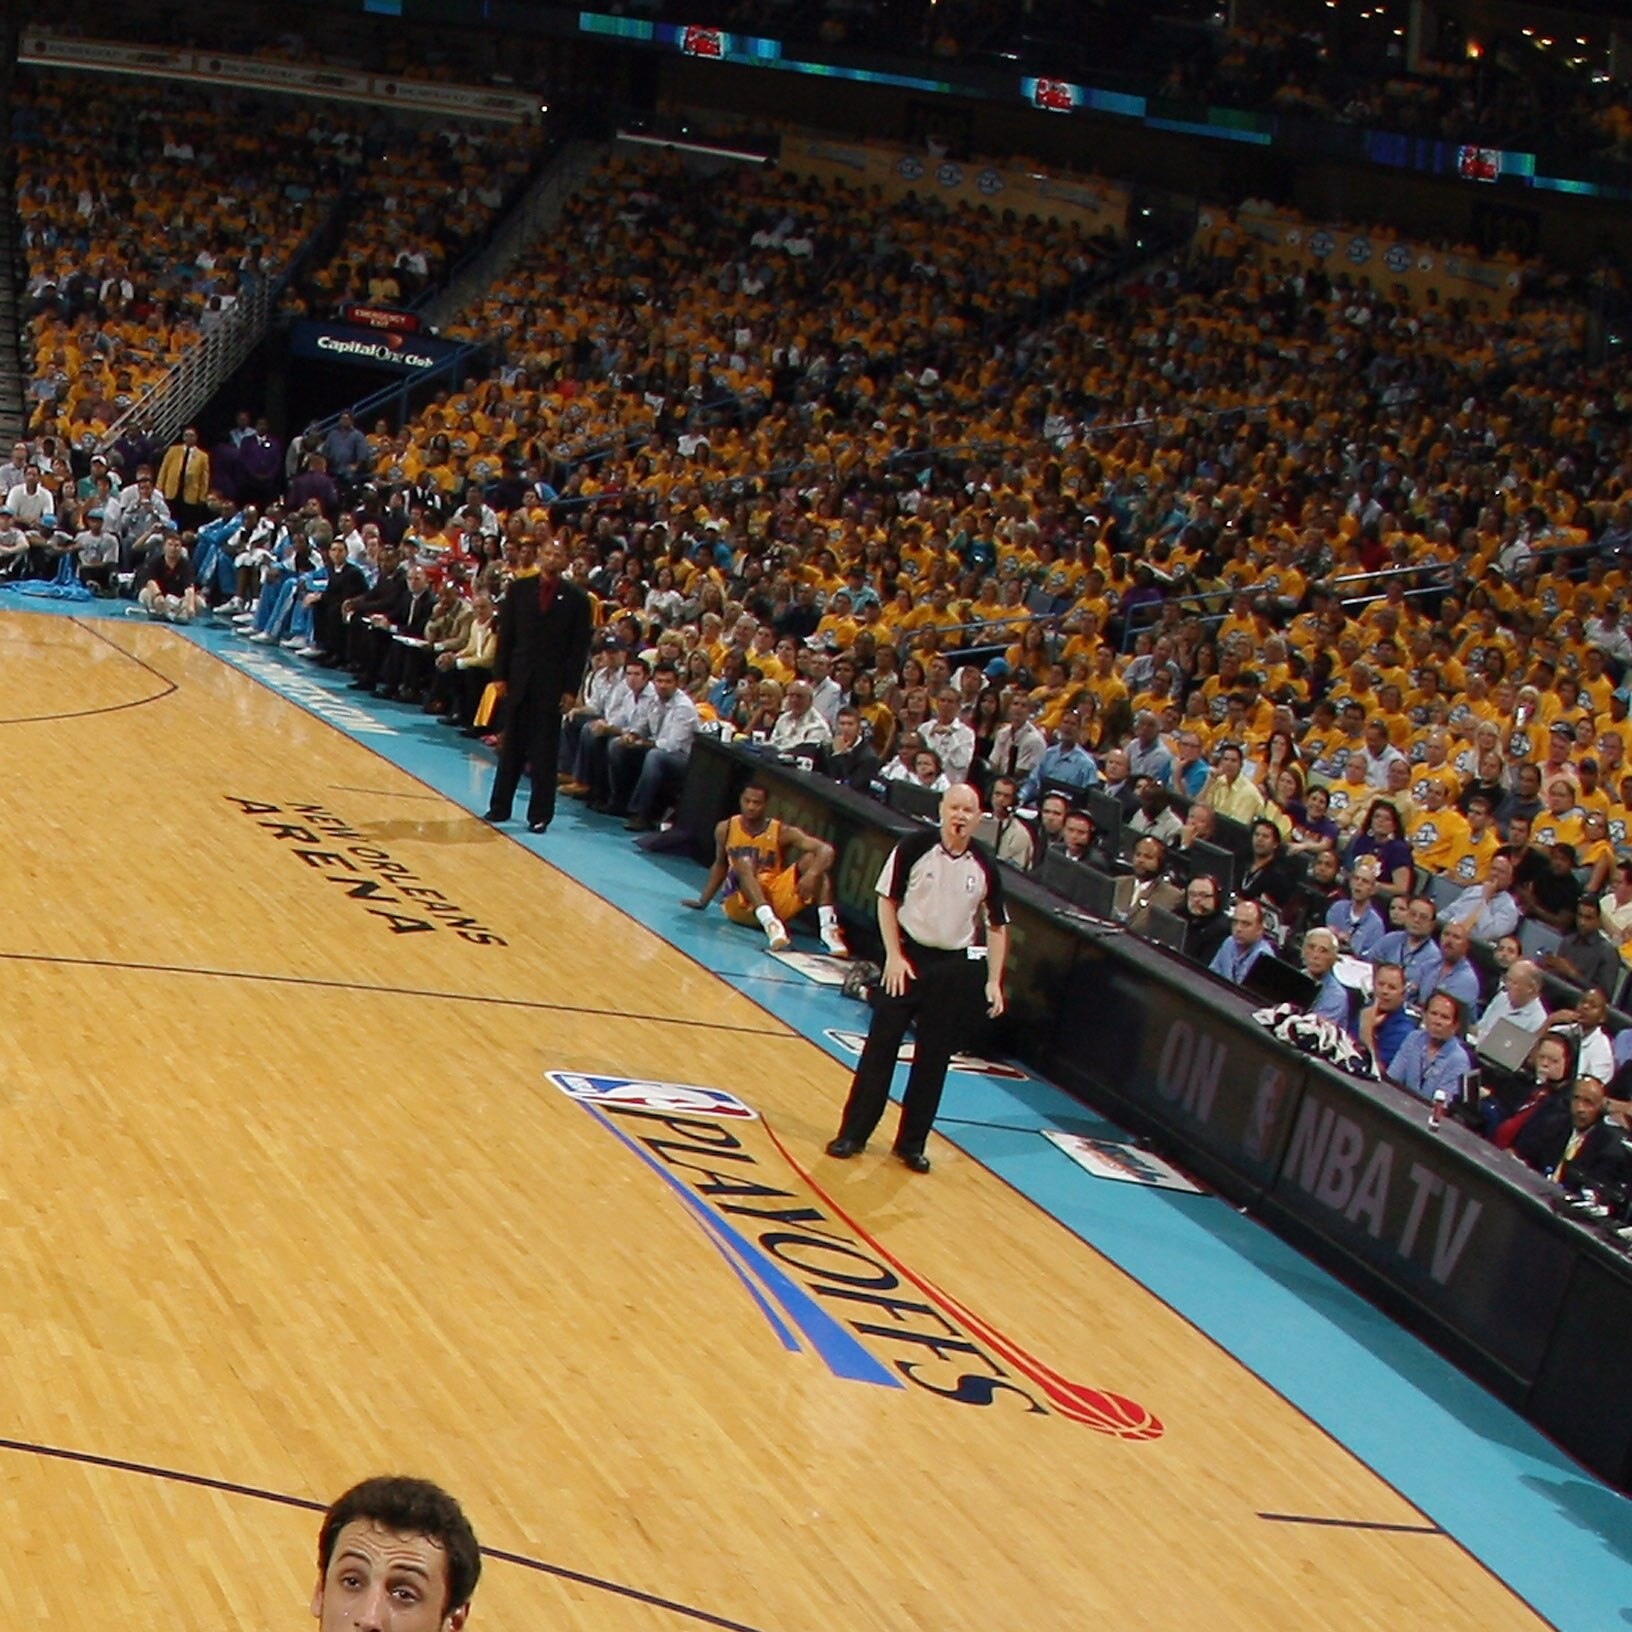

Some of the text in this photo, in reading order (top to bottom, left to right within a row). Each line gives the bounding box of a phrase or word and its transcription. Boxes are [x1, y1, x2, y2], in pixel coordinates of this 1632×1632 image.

[404, 354, 435, 369] Club
[222, 794, 437, 935] ARENA
[285, 800, 509, 948] NEW ORLEANS
[1157, 1018, 1484, 1287] ON NBA TV
[598, 1105, 1049, 1416] PLAYOFFS
